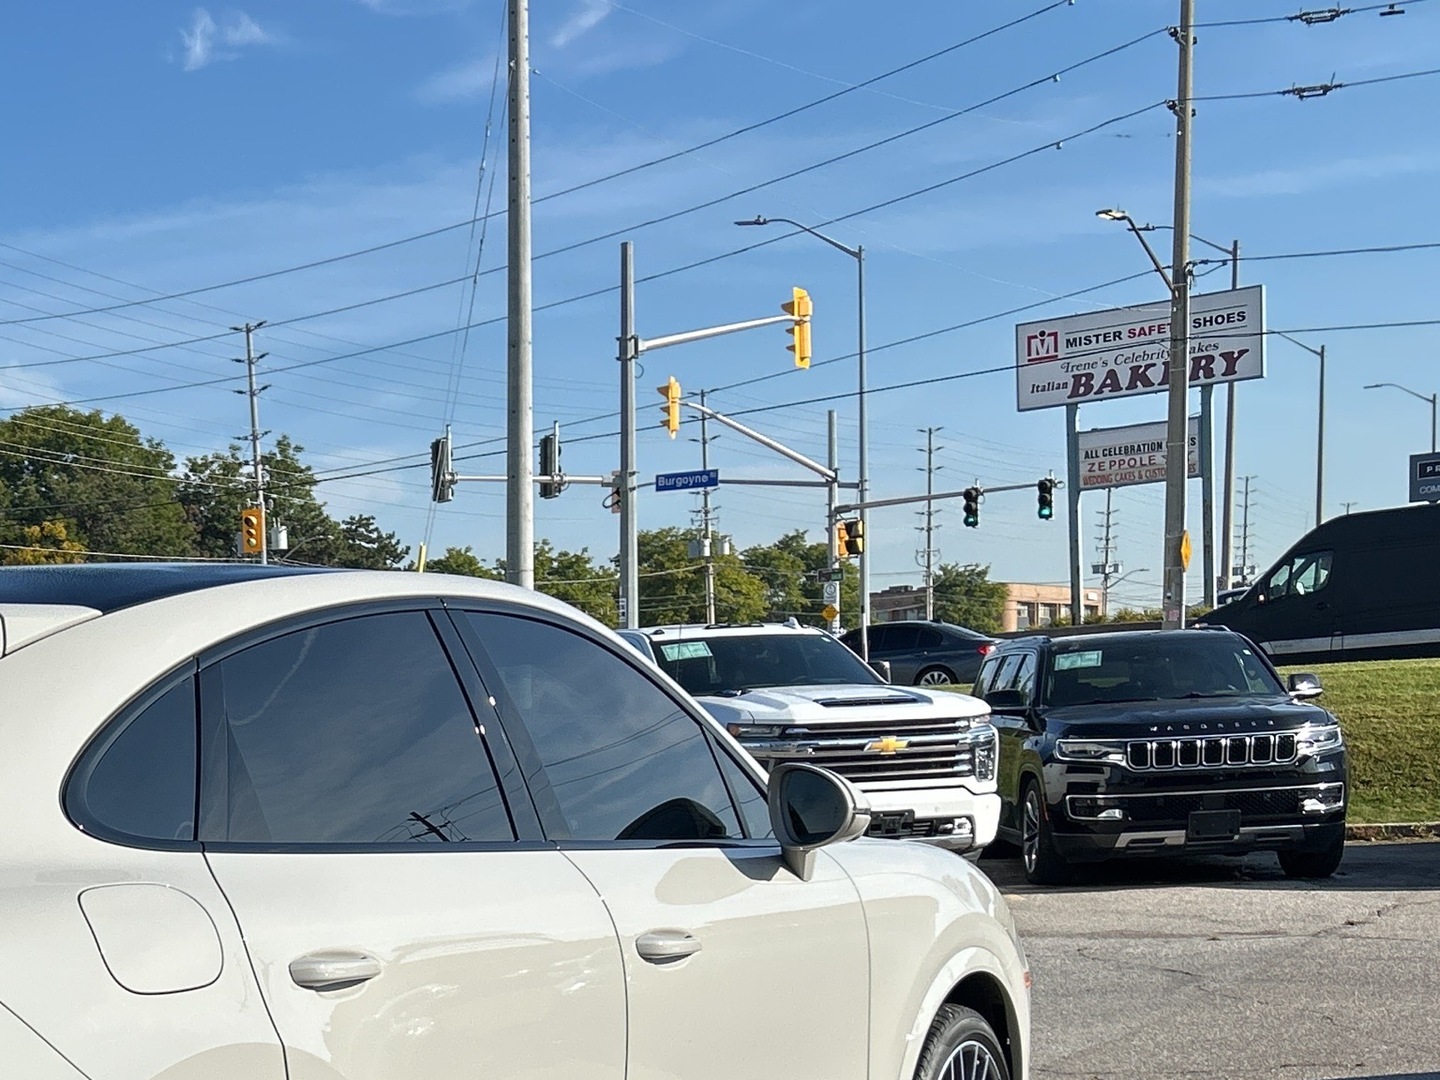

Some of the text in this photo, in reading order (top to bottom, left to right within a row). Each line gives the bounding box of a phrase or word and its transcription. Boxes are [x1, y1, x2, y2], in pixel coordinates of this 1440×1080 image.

[1065, 311, 1246, 349] MISTER SAFE SHOES
[1060, 341, 1219, 373] Irene's Celebrity akes
[1030, 381, 1068, 394] Italian
[1084, 441, 1163, 460] ALL CELEBRATION
[1087, 455, 1156, 473] ZEPPOLE
[658, 474, 709, 487] Burgoyne
[1082, 473, 1113, 486] WEDDING
[1114, 471, 1136, 481] CAKES
[1145, 467, 1167, 478] CUSTO
